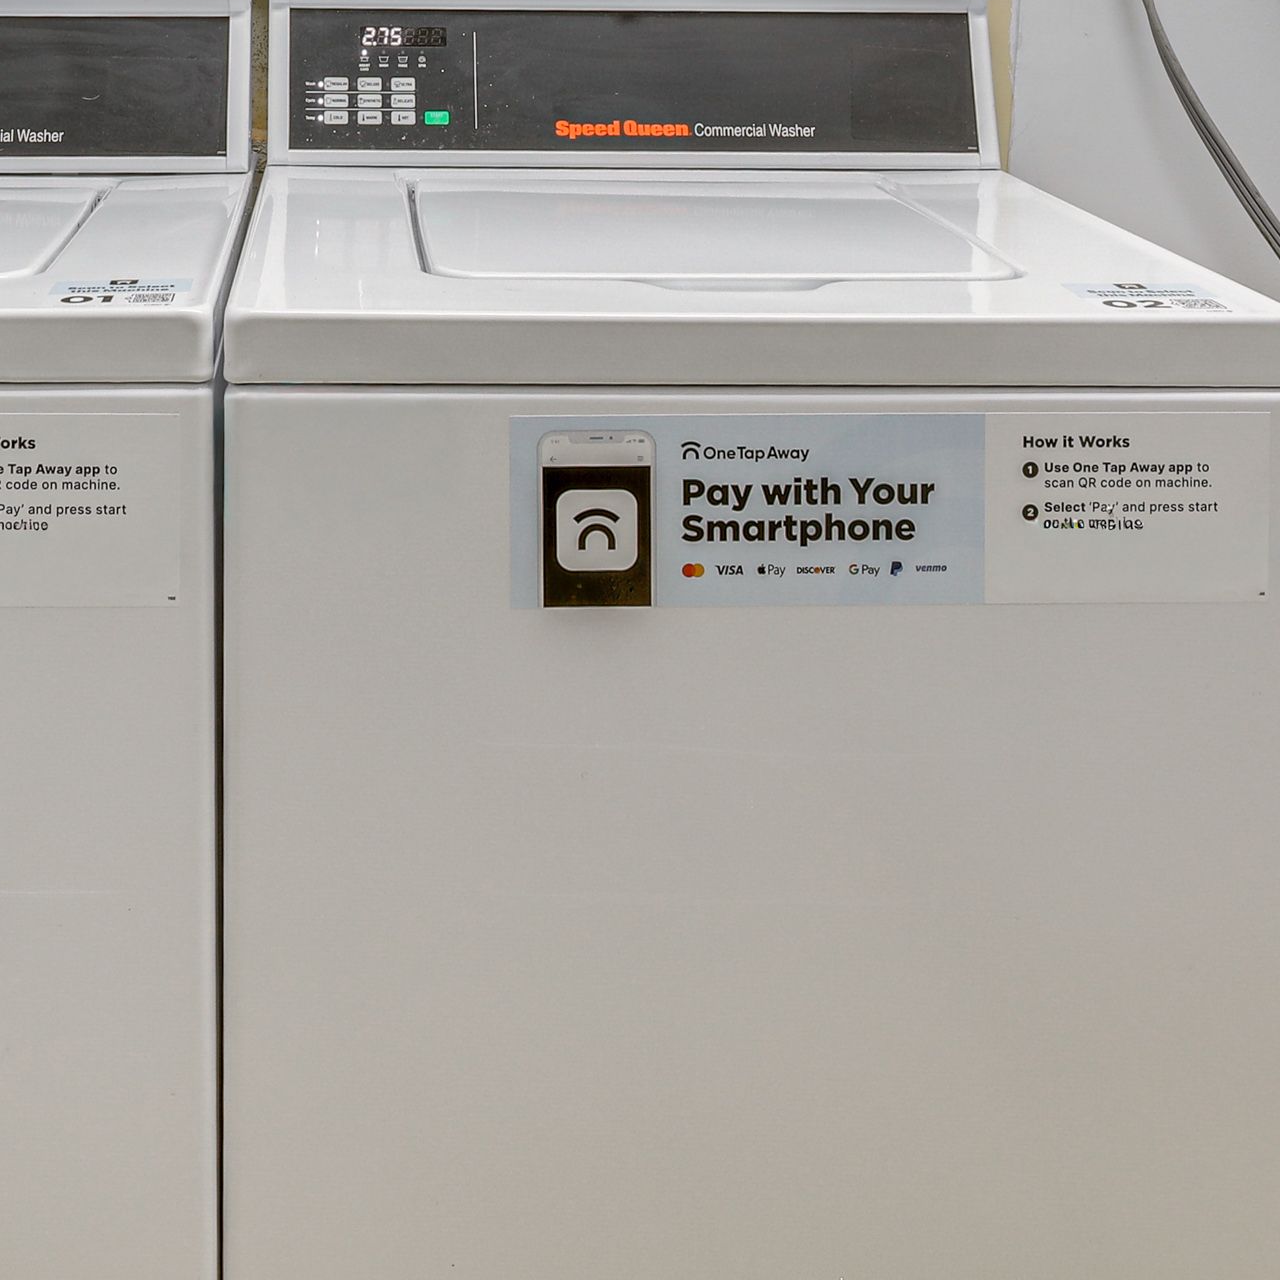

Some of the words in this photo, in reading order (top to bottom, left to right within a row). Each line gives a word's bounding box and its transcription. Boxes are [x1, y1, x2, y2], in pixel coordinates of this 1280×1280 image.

[17, 128, 65, 143] Washer
[555, 119, 621, 140] Speed
[623, 119, 689, 138] Queen
[694, 122, 767, 138] Commercial
[768, 123, 816, 138] Washer
[8, 463, 32, 477] Tap
[36, 463, 72, 477] Away
[75, 465, 101, 477] app
[104, 465, 118, 475] to
[5, 479, 38, 490] code
[41, 480, 58, 490] on
[61, 478, 121, 491] machine.
[682, 478, 754, 511] Pay
[761, 476, 842, 506] with
[848, 477, 936, 505] Your
[28, 504, 52, 515] and
[56, 505, 92, 517] press
[95, 504, 127, 515] start
[681, 512, 915, 547] Smartphone
